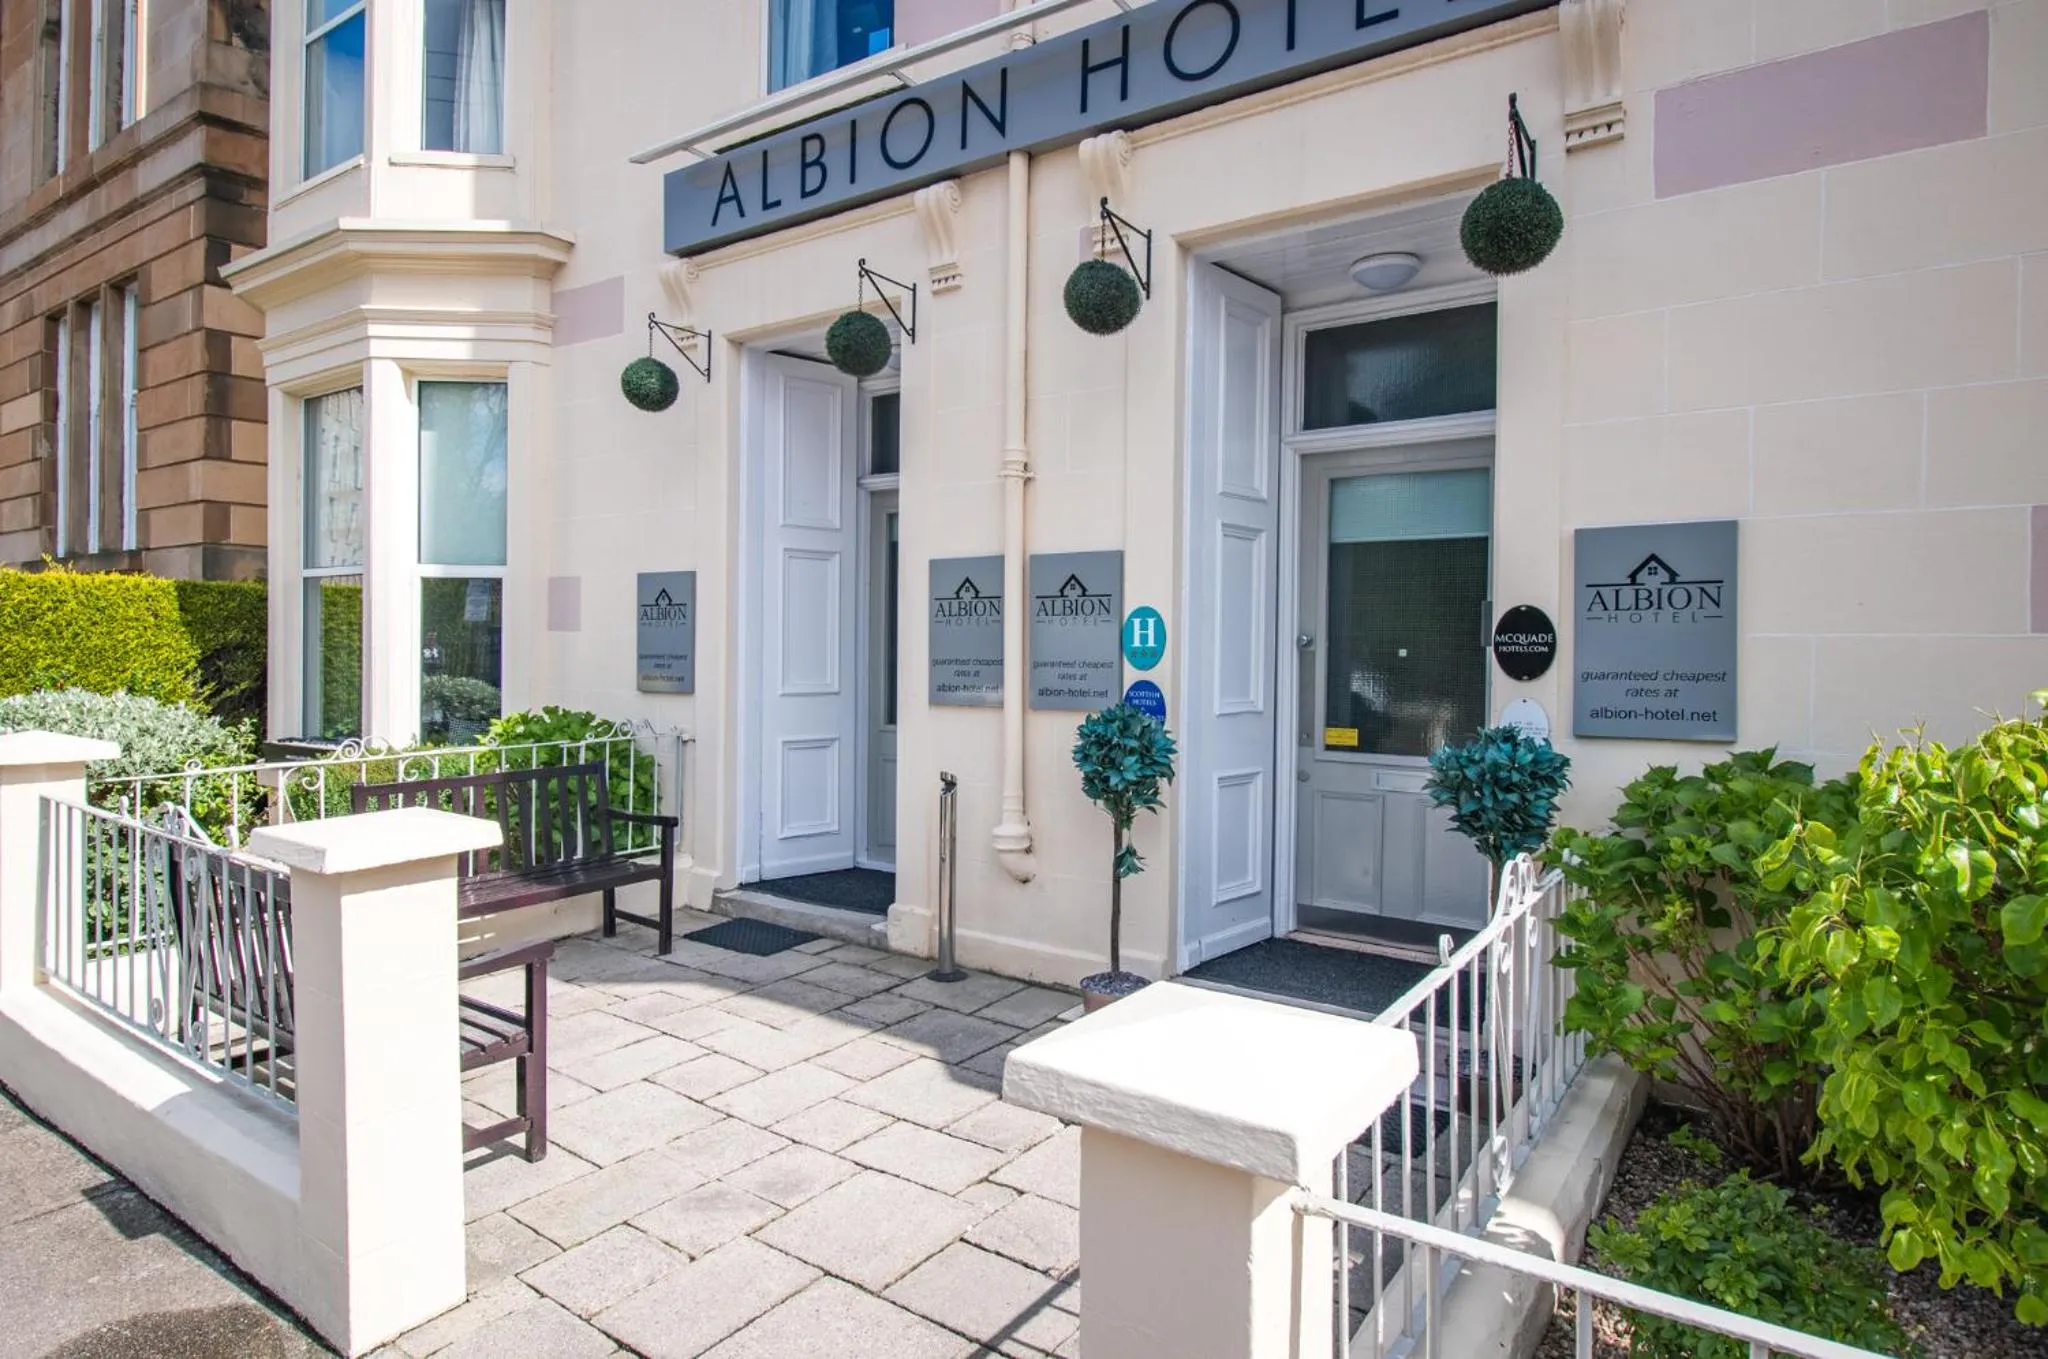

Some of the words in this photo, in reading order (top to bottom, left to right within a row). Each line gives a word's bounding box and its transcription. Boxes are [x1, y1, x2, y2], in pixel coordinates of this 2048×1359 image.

[711, 67, 1008, 227] ALBION
[1036, 598, 1112, 617] ALBION
[1585, 586, 1724, 613] ALBION
[641, 607, 687, 621] ALBION
[935, 600, 1001, 618] ALBION
[1607, 611, 1698, 624] HOTEL
[1130, 617, 1158, 648] H
[1495, 632, 1554, 645] MCQUADE
[1580, 668, 1658, 682] guaranteed
[1663, 669, 1727, 684] cheapest
[1038, 687, 1109, 698] albion-hotel.net
[1625, 686, 1660, 698] rates
[1663, 687, 1679, 698] at
[1589, 706, 1718, 722] albion-hotel.net
